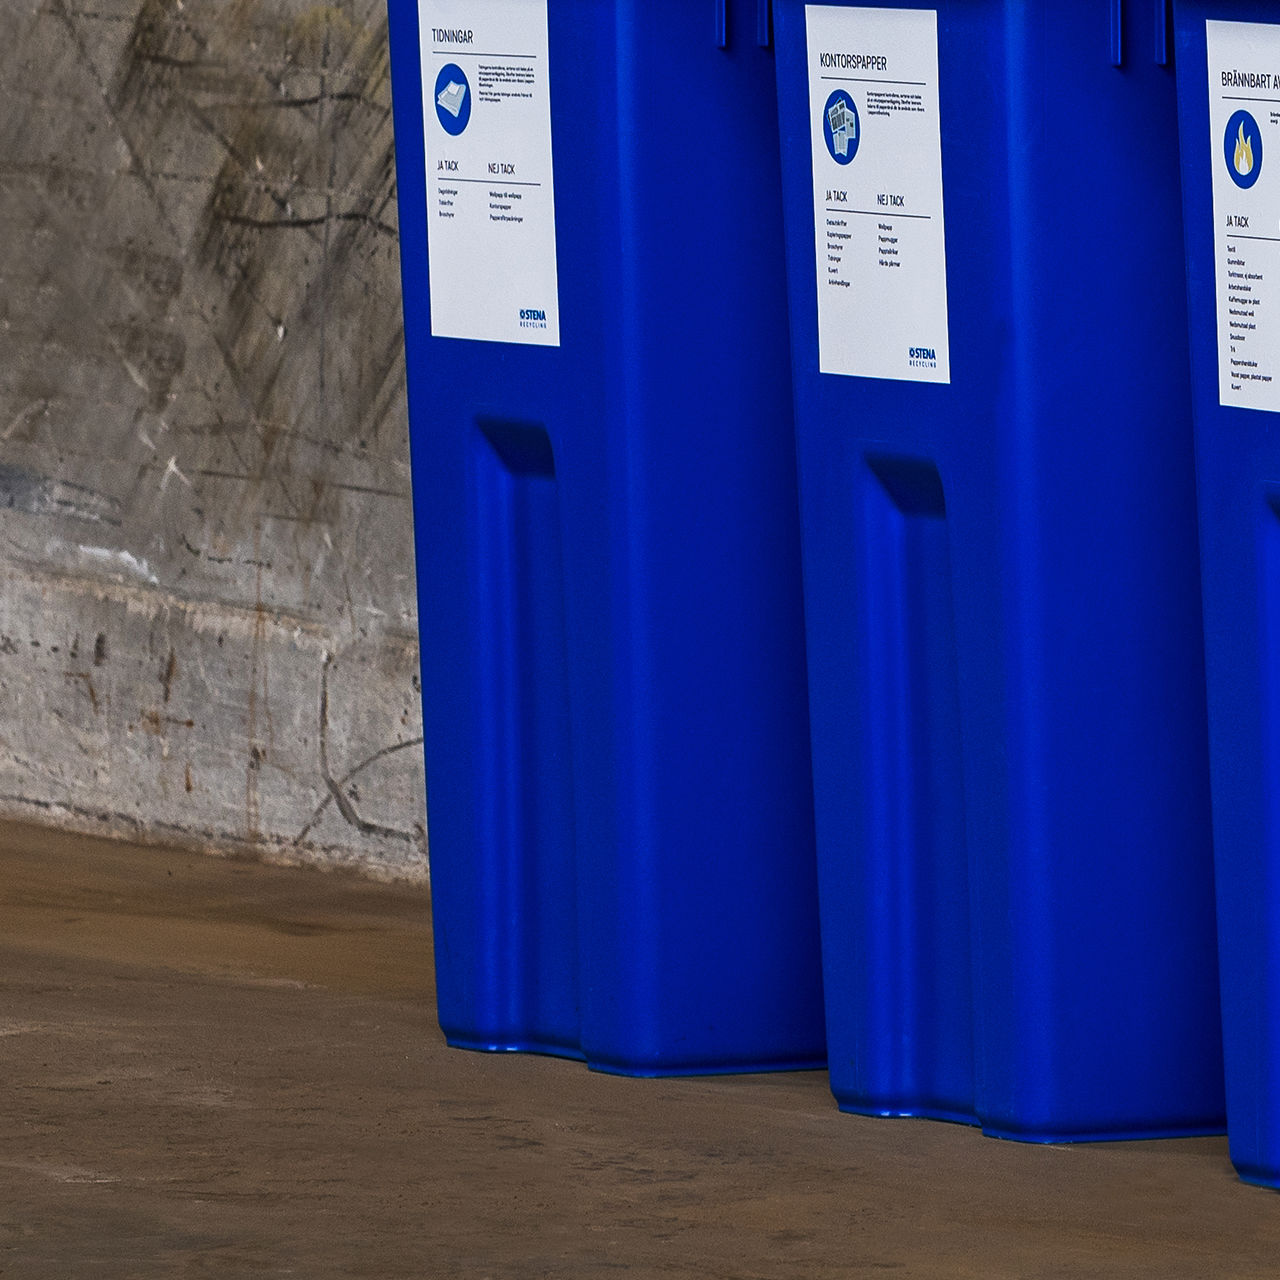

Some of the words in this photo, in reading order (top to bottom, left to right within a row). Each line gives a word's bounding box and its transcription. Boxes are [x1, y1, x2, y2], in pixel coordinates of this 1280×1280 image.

[432, 29, 473, 44] TIDNINGAR
[820, 53, 887, 70] KONTORSPAPPER
[1222, 70, 1271, 89] BRÄNNBART
[438, 160, 443, 170] JA
[445, 160, 458, 171] TACK
[488, 163, 499, 174] NEJ
[501, 164, 515, 174] TACK
[826, 190, 832, 201] JA
[834, 190, 847, 202] TACK
[877, 194, 888, 205] NEJ
[890, 195, 904, 207] TACK
[1226, 216, 1232, 227] JA
[1234, 216, 1249, 228] TACK
[526, 310, 546, 320] STENA
[916, 348, 936, 360] STENA
